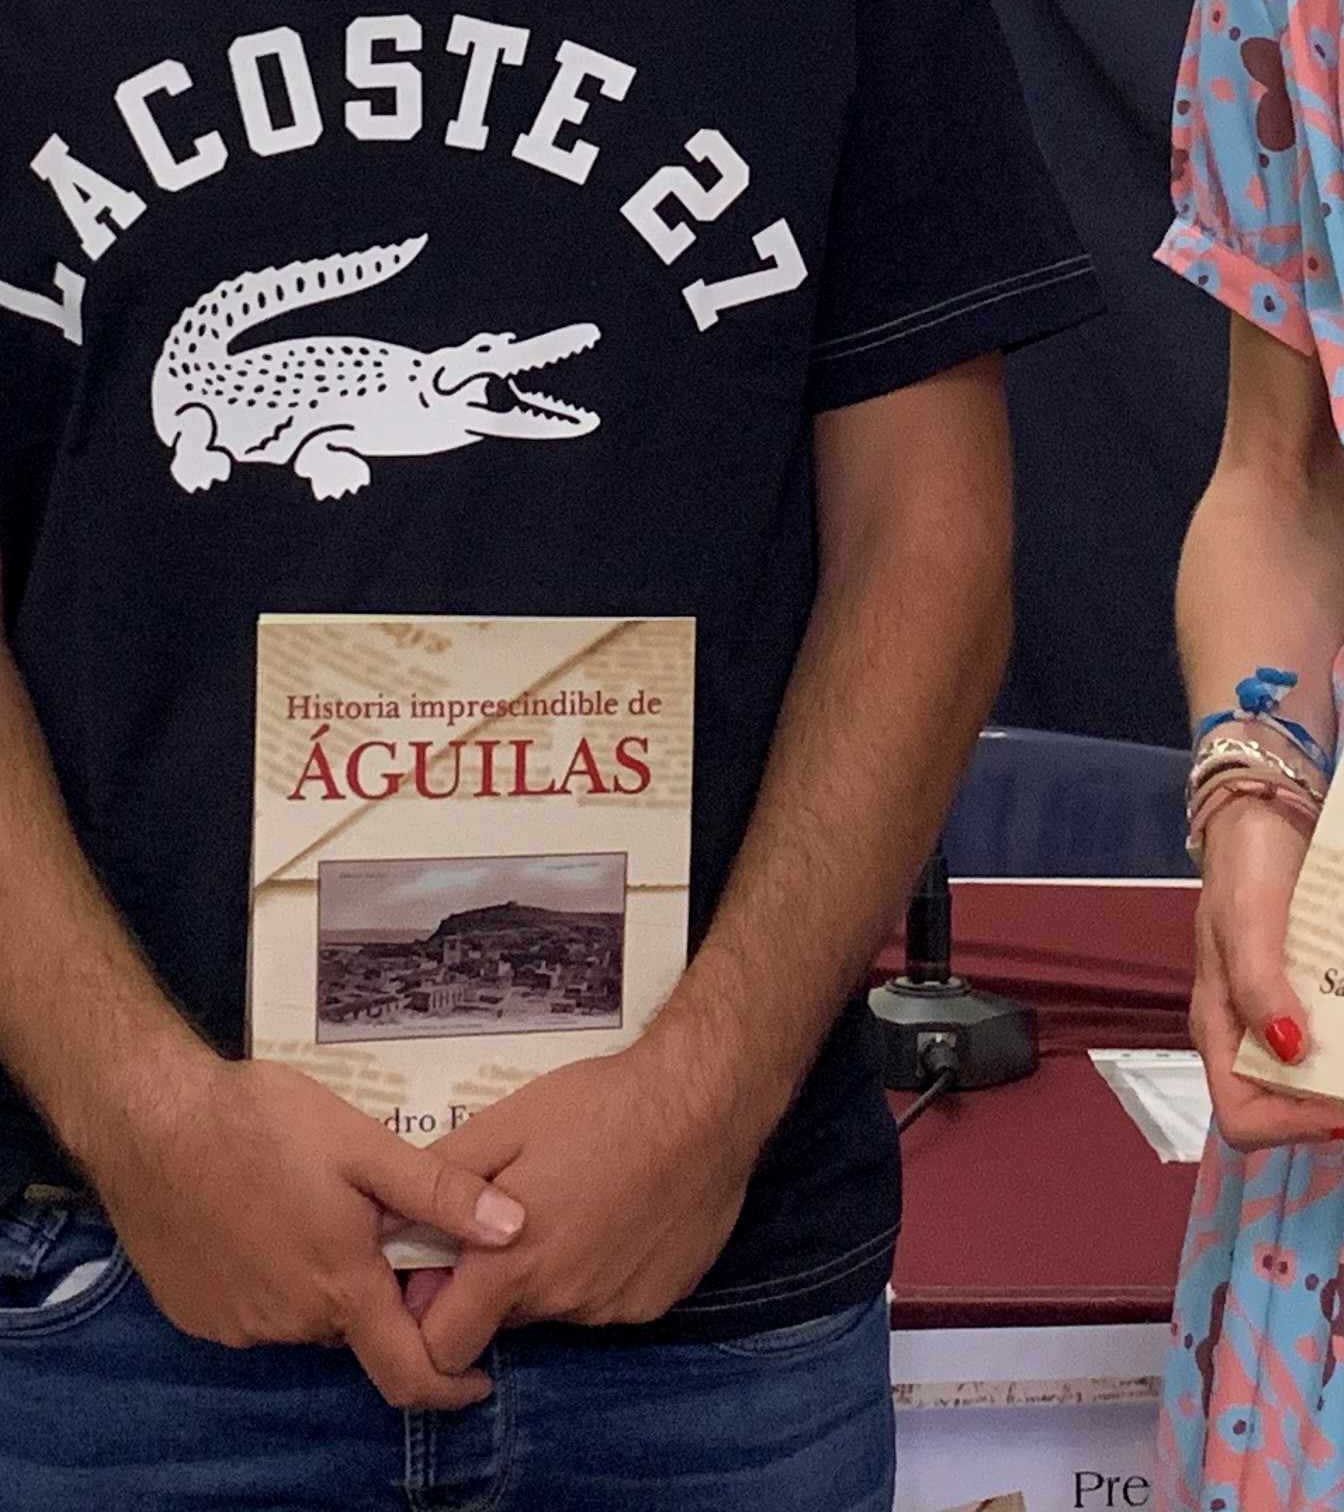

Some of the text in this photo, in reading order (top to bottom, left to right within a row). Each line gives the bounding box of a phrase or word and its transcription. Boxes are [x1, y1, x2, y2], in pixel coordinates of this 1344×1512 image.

[619, 128, 808, 332] 27
[287, 690, 663, 726] Historia imprescindible de
[287, 723, 652, 801] ÁGUILAS
[384, 1107, 436, 1133] dro
[1074, 1471, 1150, 1508] Pre
